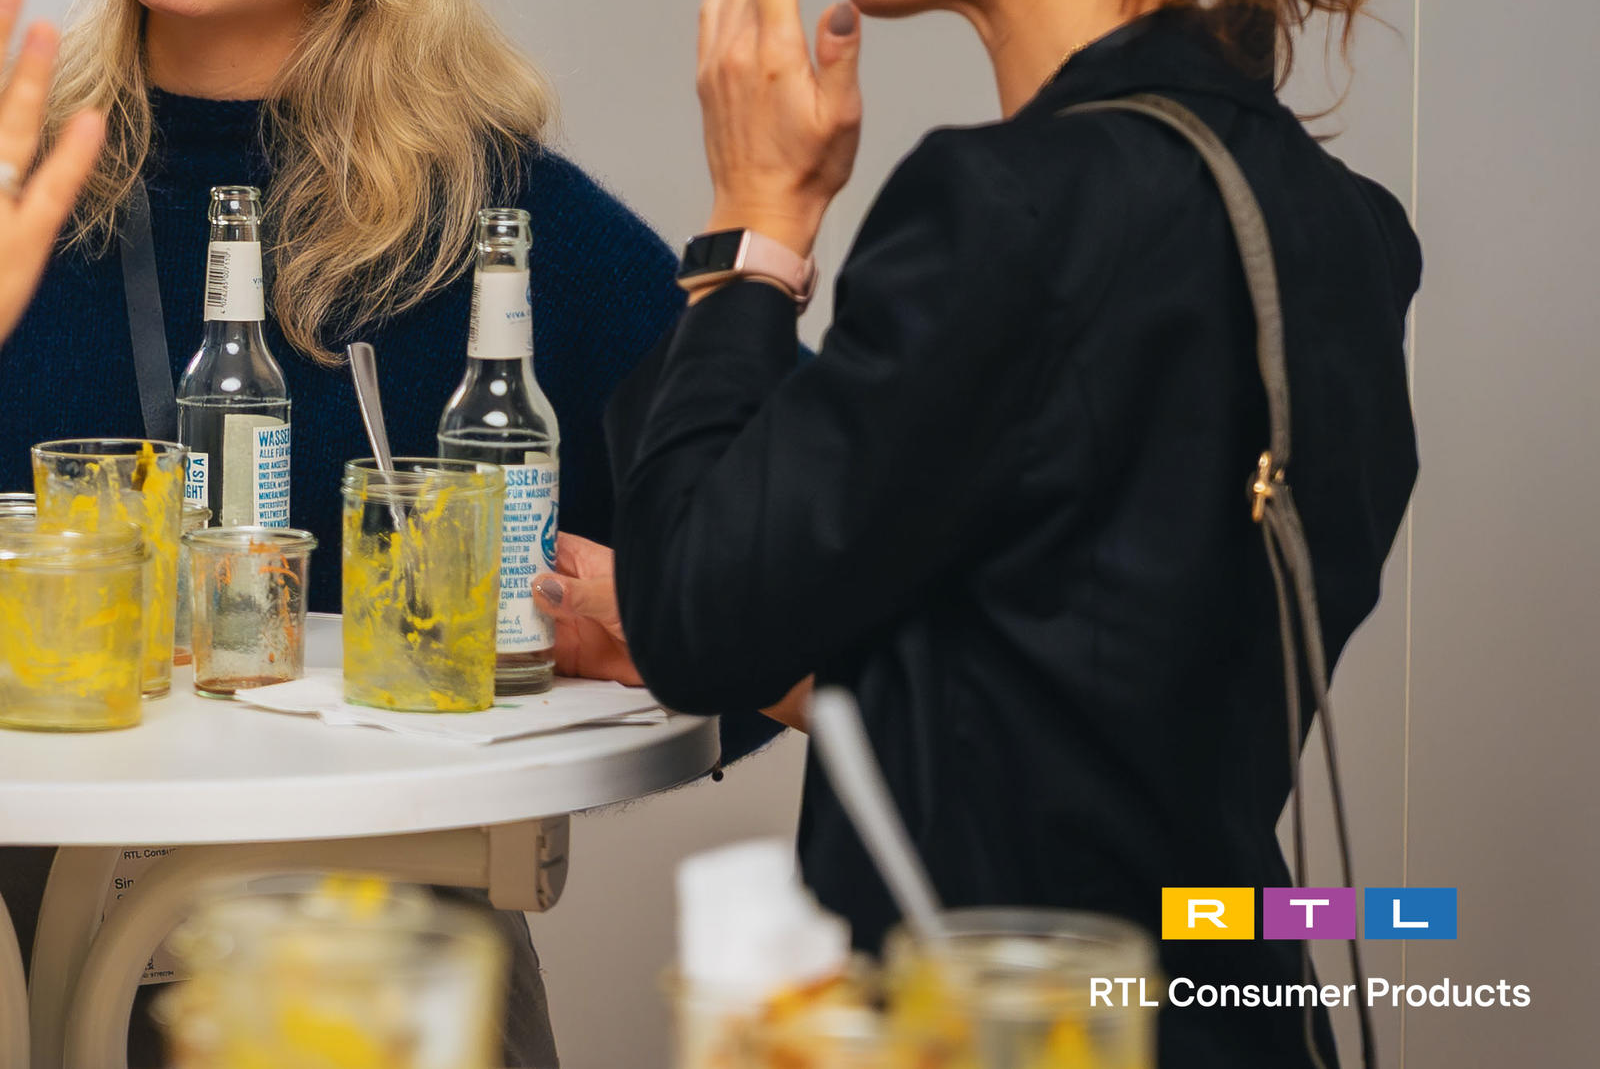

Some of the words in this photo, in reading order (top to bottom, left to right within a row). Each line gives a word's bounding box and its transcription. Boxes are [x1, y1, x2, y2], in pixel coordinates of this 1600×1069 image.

[260, 448, 274, 459] ALLE
[193, 458, 205, 467] A
[504, 468, 539, 486] SSER
[507, 488, 523, 499] FÜR
[123, 850, 141, 860] RTL
